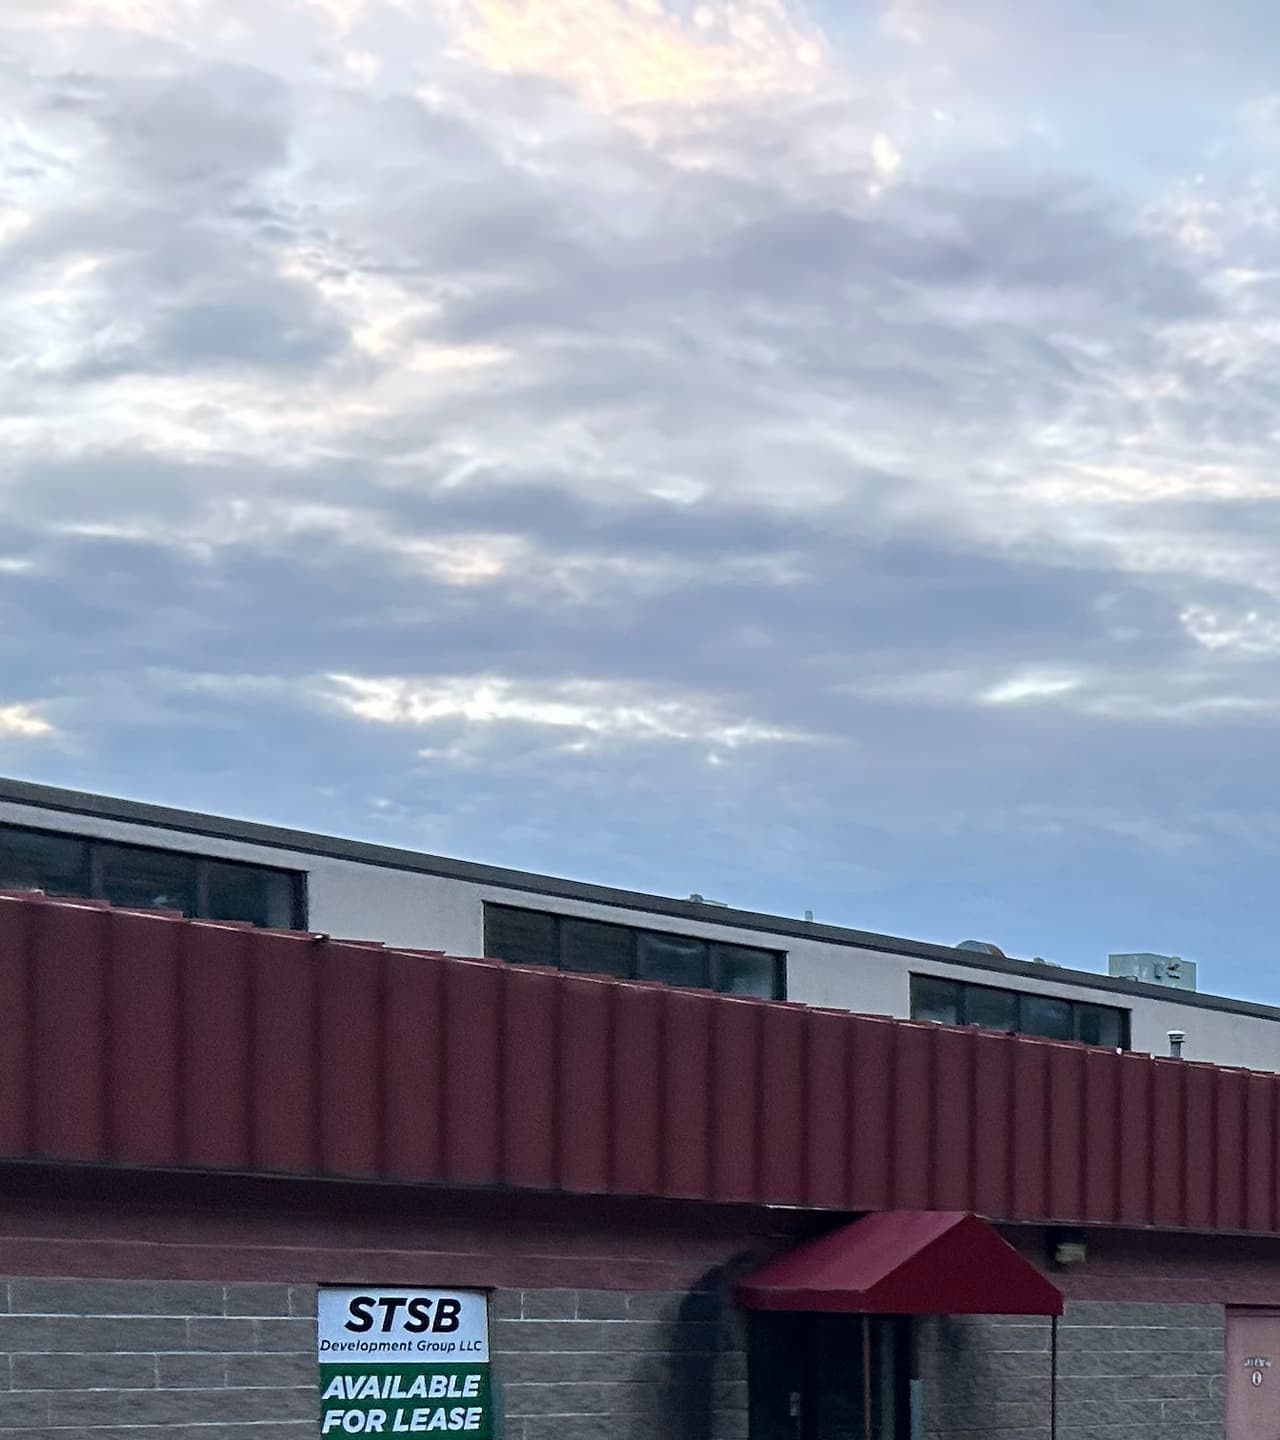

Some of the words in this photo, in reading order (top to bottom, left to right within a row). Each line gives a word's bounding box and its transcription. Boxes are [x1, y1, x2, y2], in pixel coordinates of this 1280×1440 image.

[344, 1296, 462, 1333] STSB
[320, 1339, 413, 1353] Development
[417, 1340, 456, 1353] Group
[460, 1340, 482, 1351] LLC
[321, 1374, 481, 1400] AVAILABLE
[321, 1409, 386, 1434] FOR
[392, 1407, 483, 1432] LEASE
